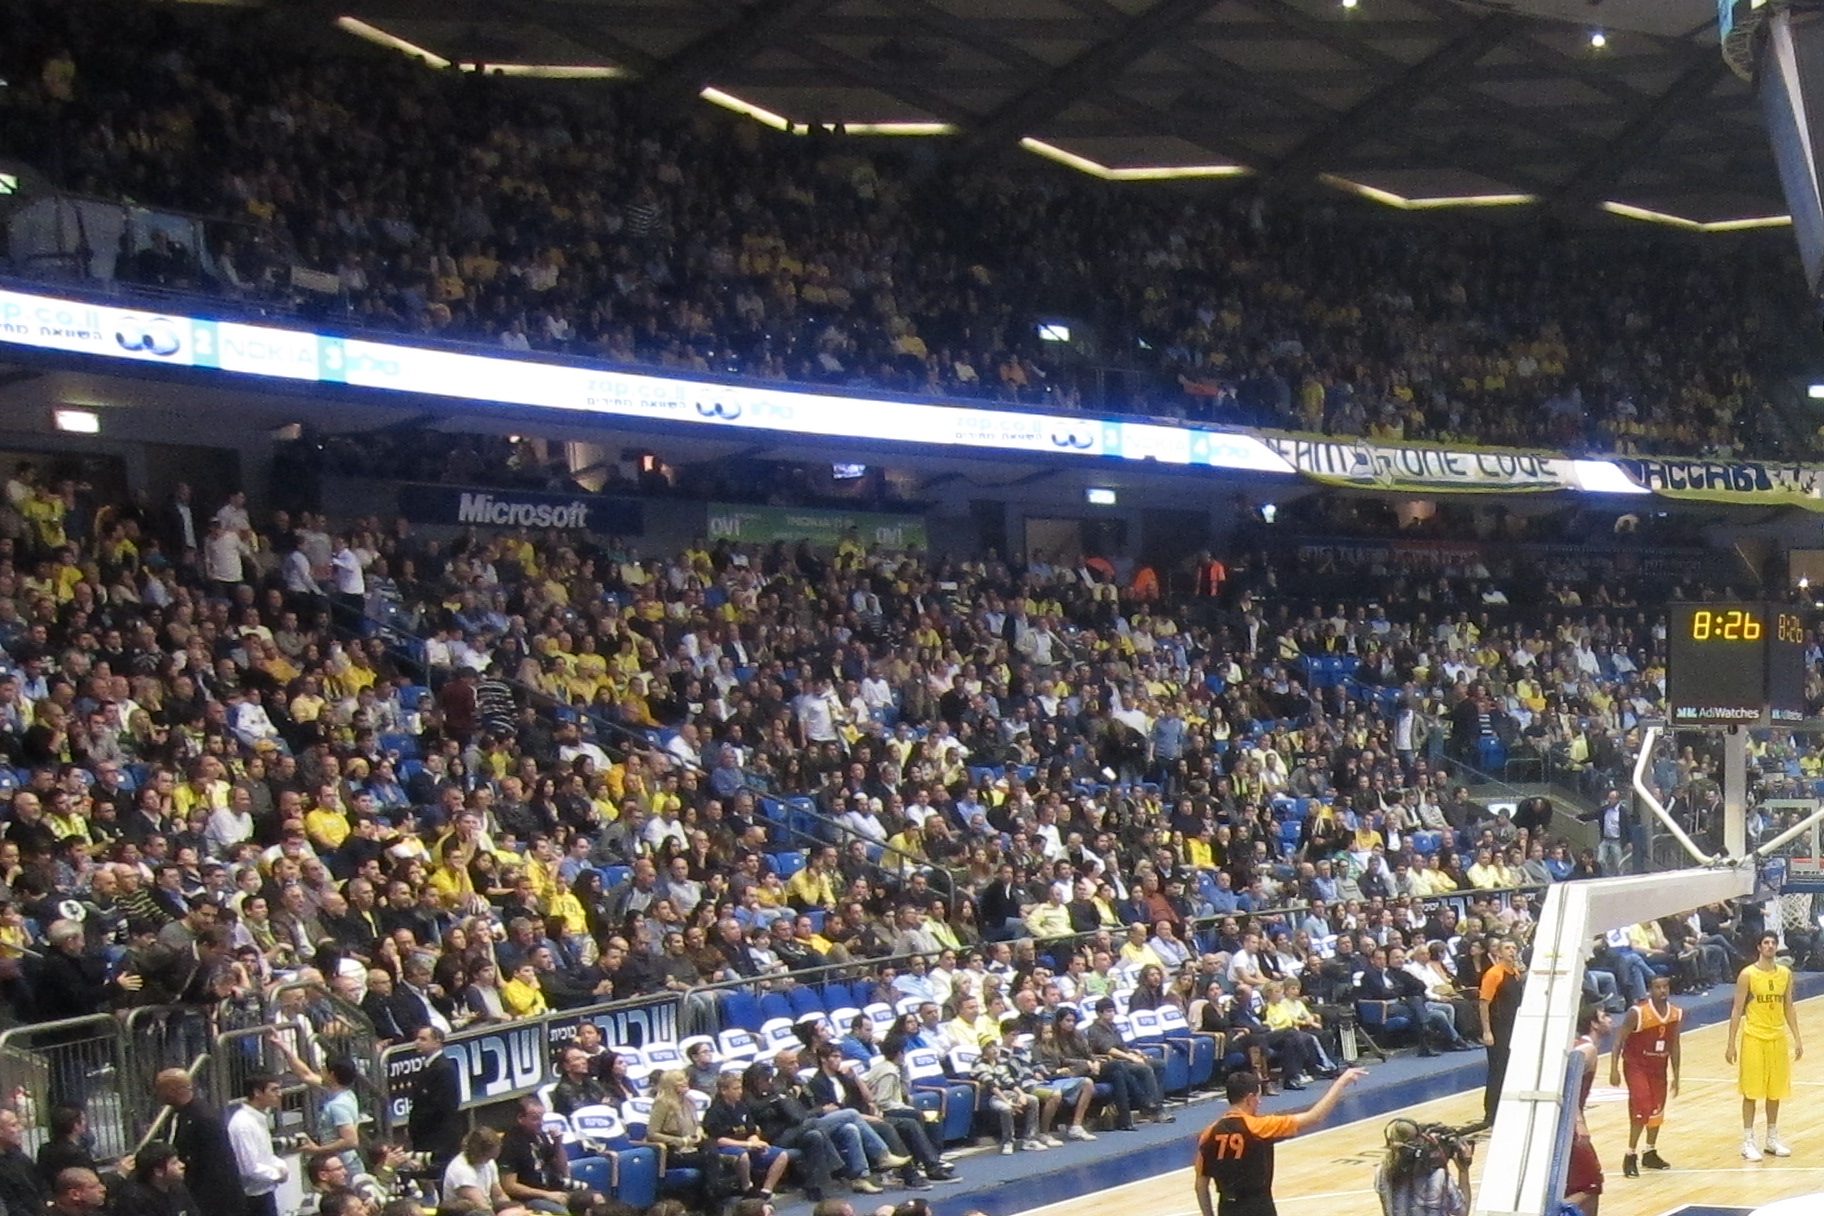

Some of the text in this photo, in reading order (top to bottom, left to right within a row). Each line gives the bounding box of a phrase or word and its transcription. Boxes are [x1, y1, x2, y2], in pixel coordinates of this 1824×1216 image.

[223, 337, 314, 364] NOKIA
[458, 492, 587, 530] Microsoft
[1693, 611, 1760, 640] 8:26
[442, 1026, 542, 1103] שביר
[1214, 1133, 1246, 1161] 79
